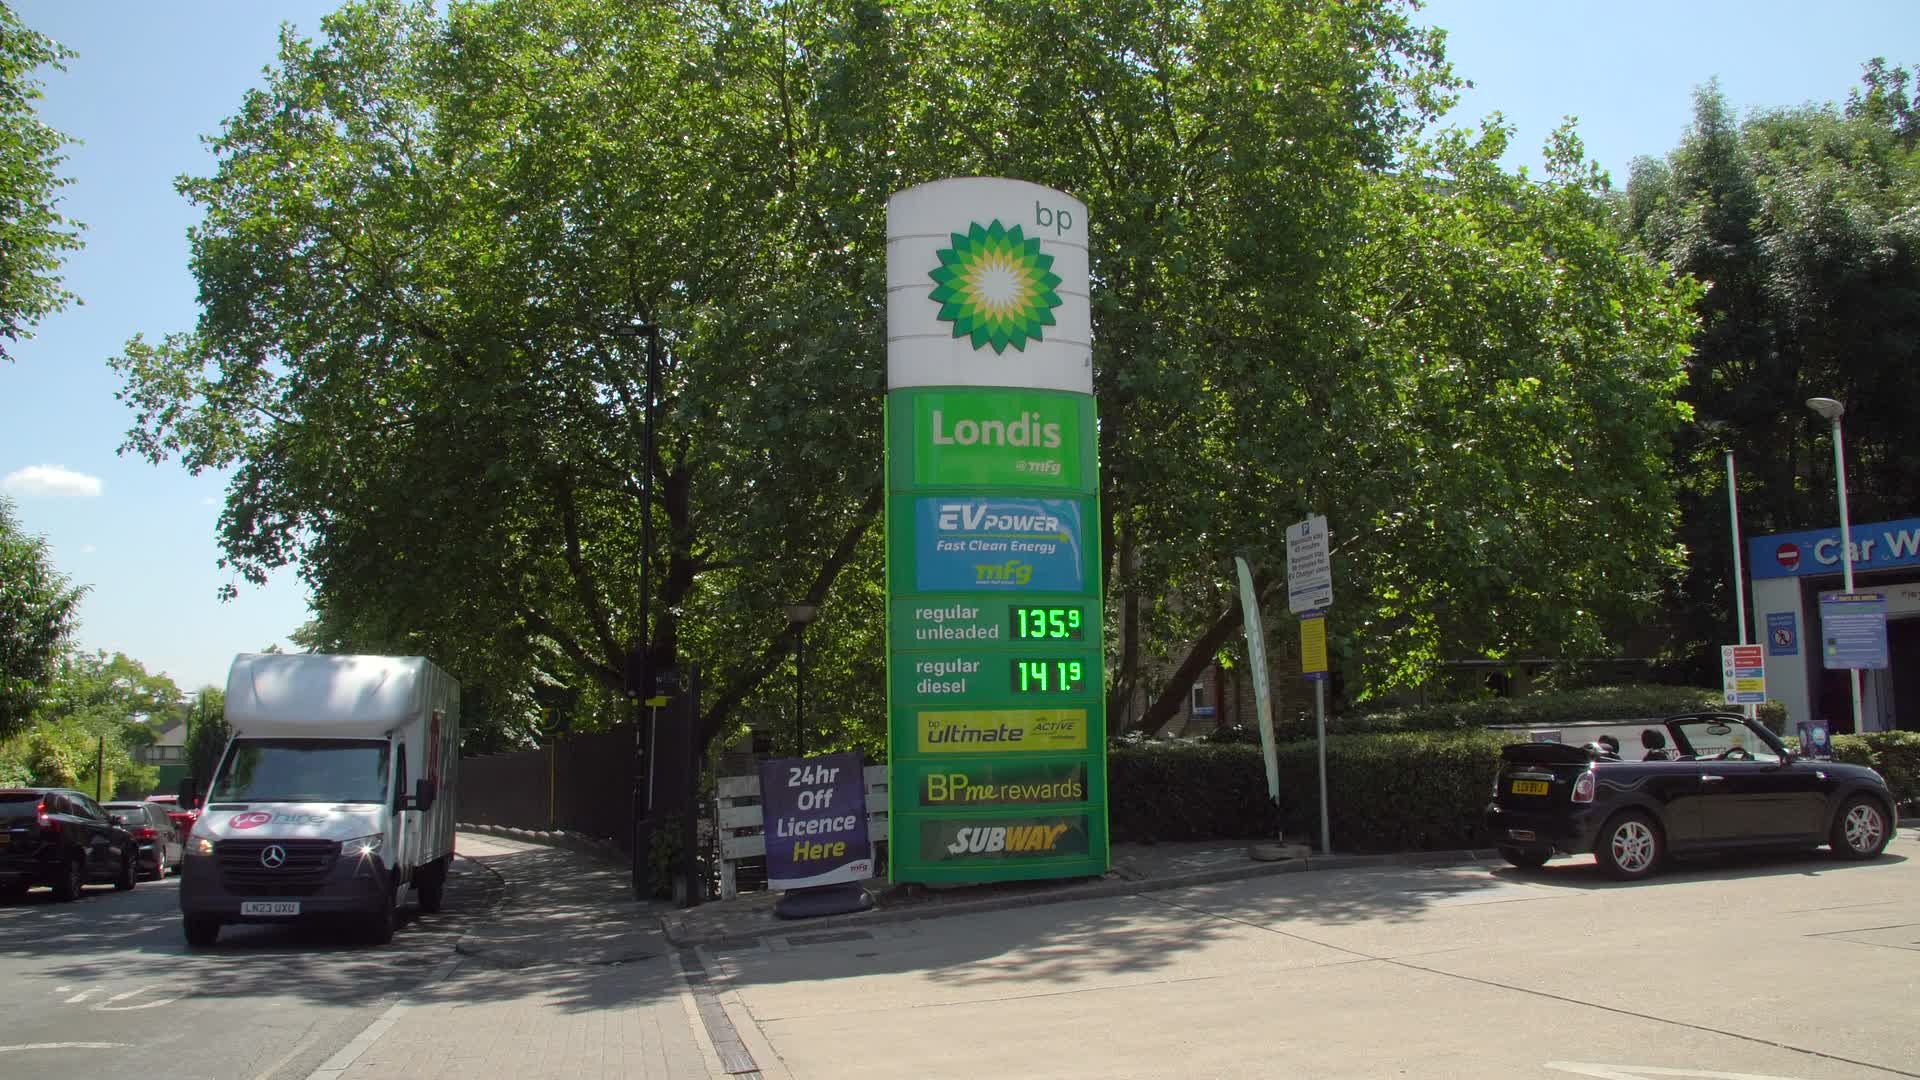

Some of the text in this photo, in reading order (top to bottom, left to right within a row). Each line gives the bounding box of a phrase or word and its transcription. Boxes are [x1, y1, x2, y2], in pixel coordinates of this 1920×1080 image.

[1035, 200, 1072, 236] bp
[932, 410, 1062, 449] Londis
[936, 540, 1056, 554] Fast Clean Energy
[975, 559, 1033, 584] mfg
[915, 604, 980, 623] regular
[1017, 609, 1080, 639] 135.9
[915, 624, 1000, 640] unleaded
[916, 658, 981, 677] regular
[1018, 662, 1082, 692] 141.9
[916, 678, 967, 694] diesel
[927, 723, 1024, 744] ultimate
[1033, 721, 1076, 732] ACTIVE
[928, 719, 940, 730] bp
[788, 765, 840, 787] 24hr
[797, 788, 834, 811] Off
[1000, 778, 1083, 800] rewards
[777, 815, 857, 838] Licence
[947, 823, 1069, 854] SUBWAY
[792, 840, 847, 863] Here
